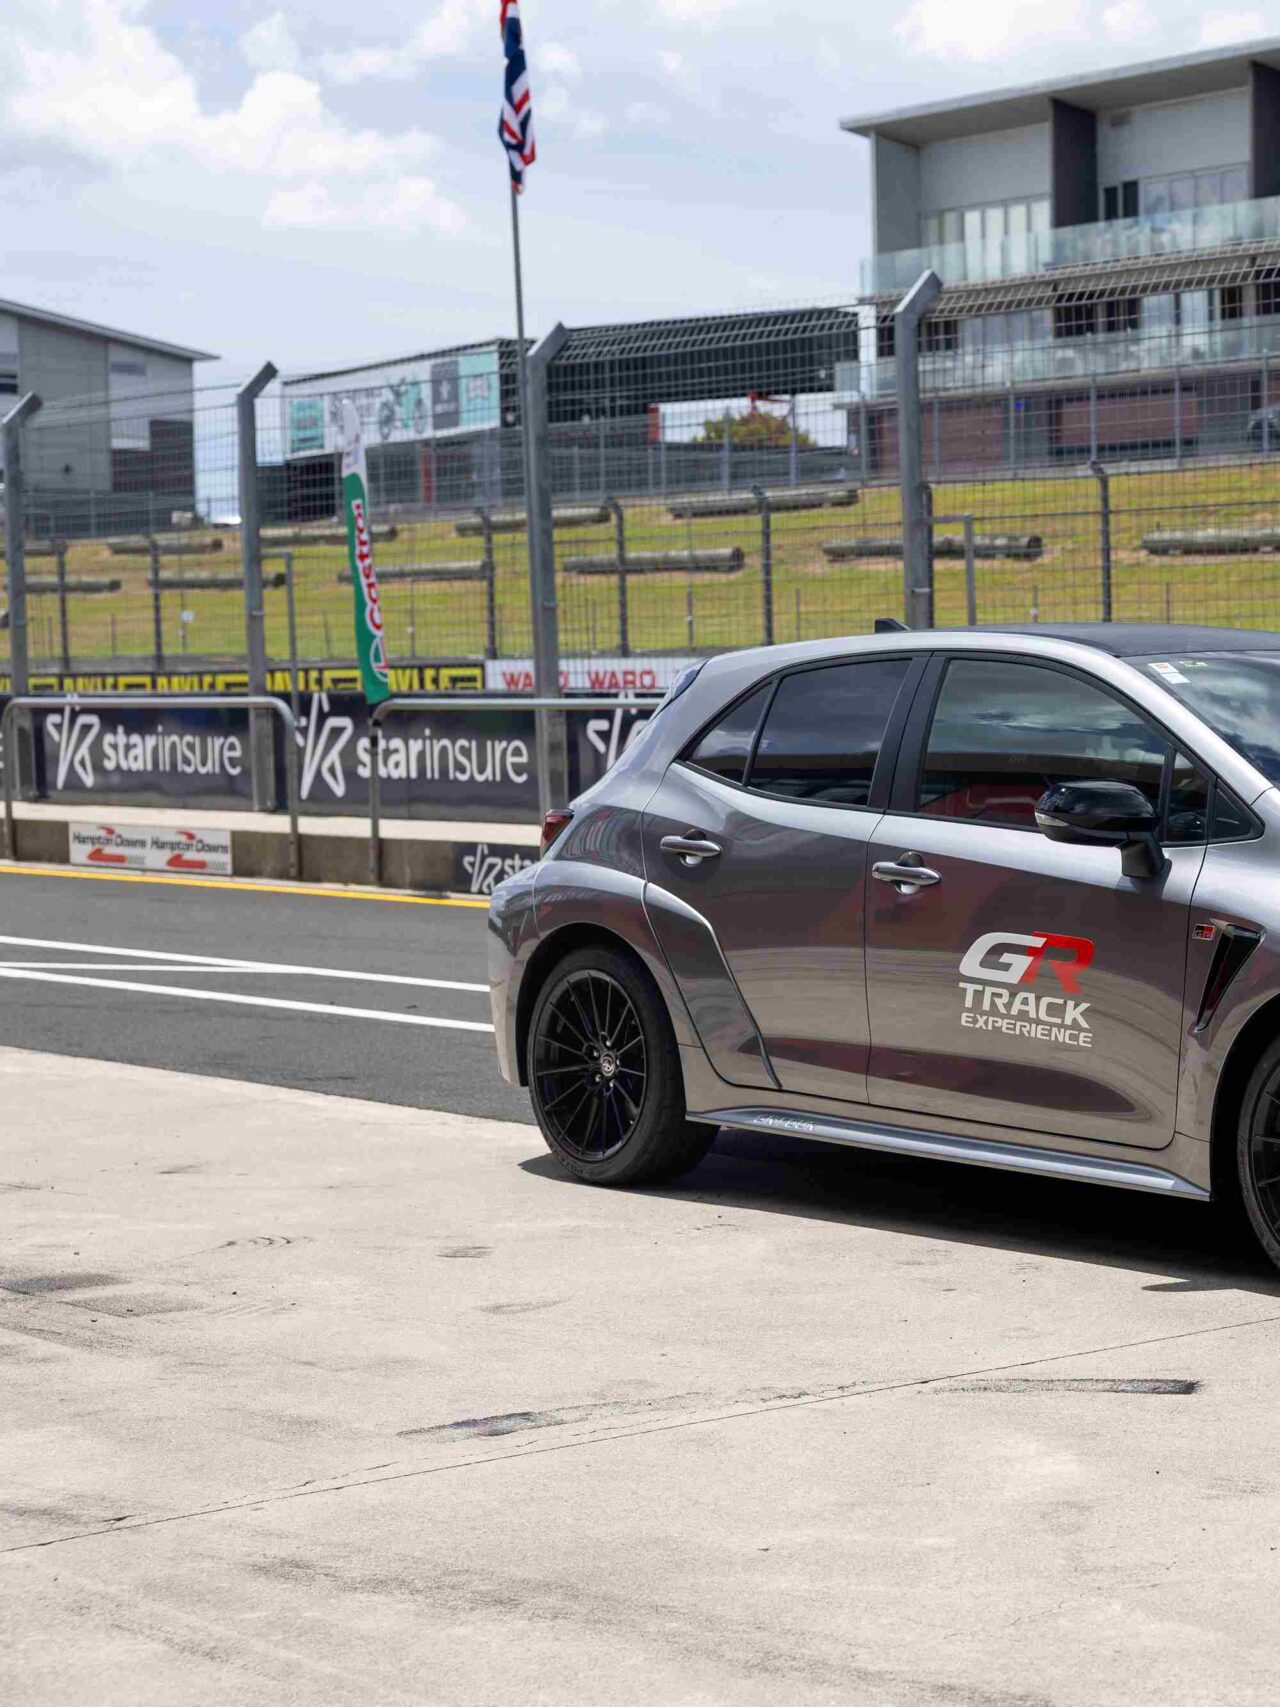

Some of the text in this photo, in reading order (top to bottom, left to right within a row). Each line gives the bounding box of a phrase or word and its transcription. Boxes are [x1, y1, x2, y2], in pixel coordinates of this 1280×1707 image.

[502, 671, 569, 690] WAO
[587, 670, 657, 690] WARO
[102, 724, 243, 776] starinsure
[356, 727, 529, 784] starinsure
[958, 931, 1095, 994] GR
[958, 982, 1093, 1029] TRACK
[960, 1012, 1094, 1048] EXPERIENCE
